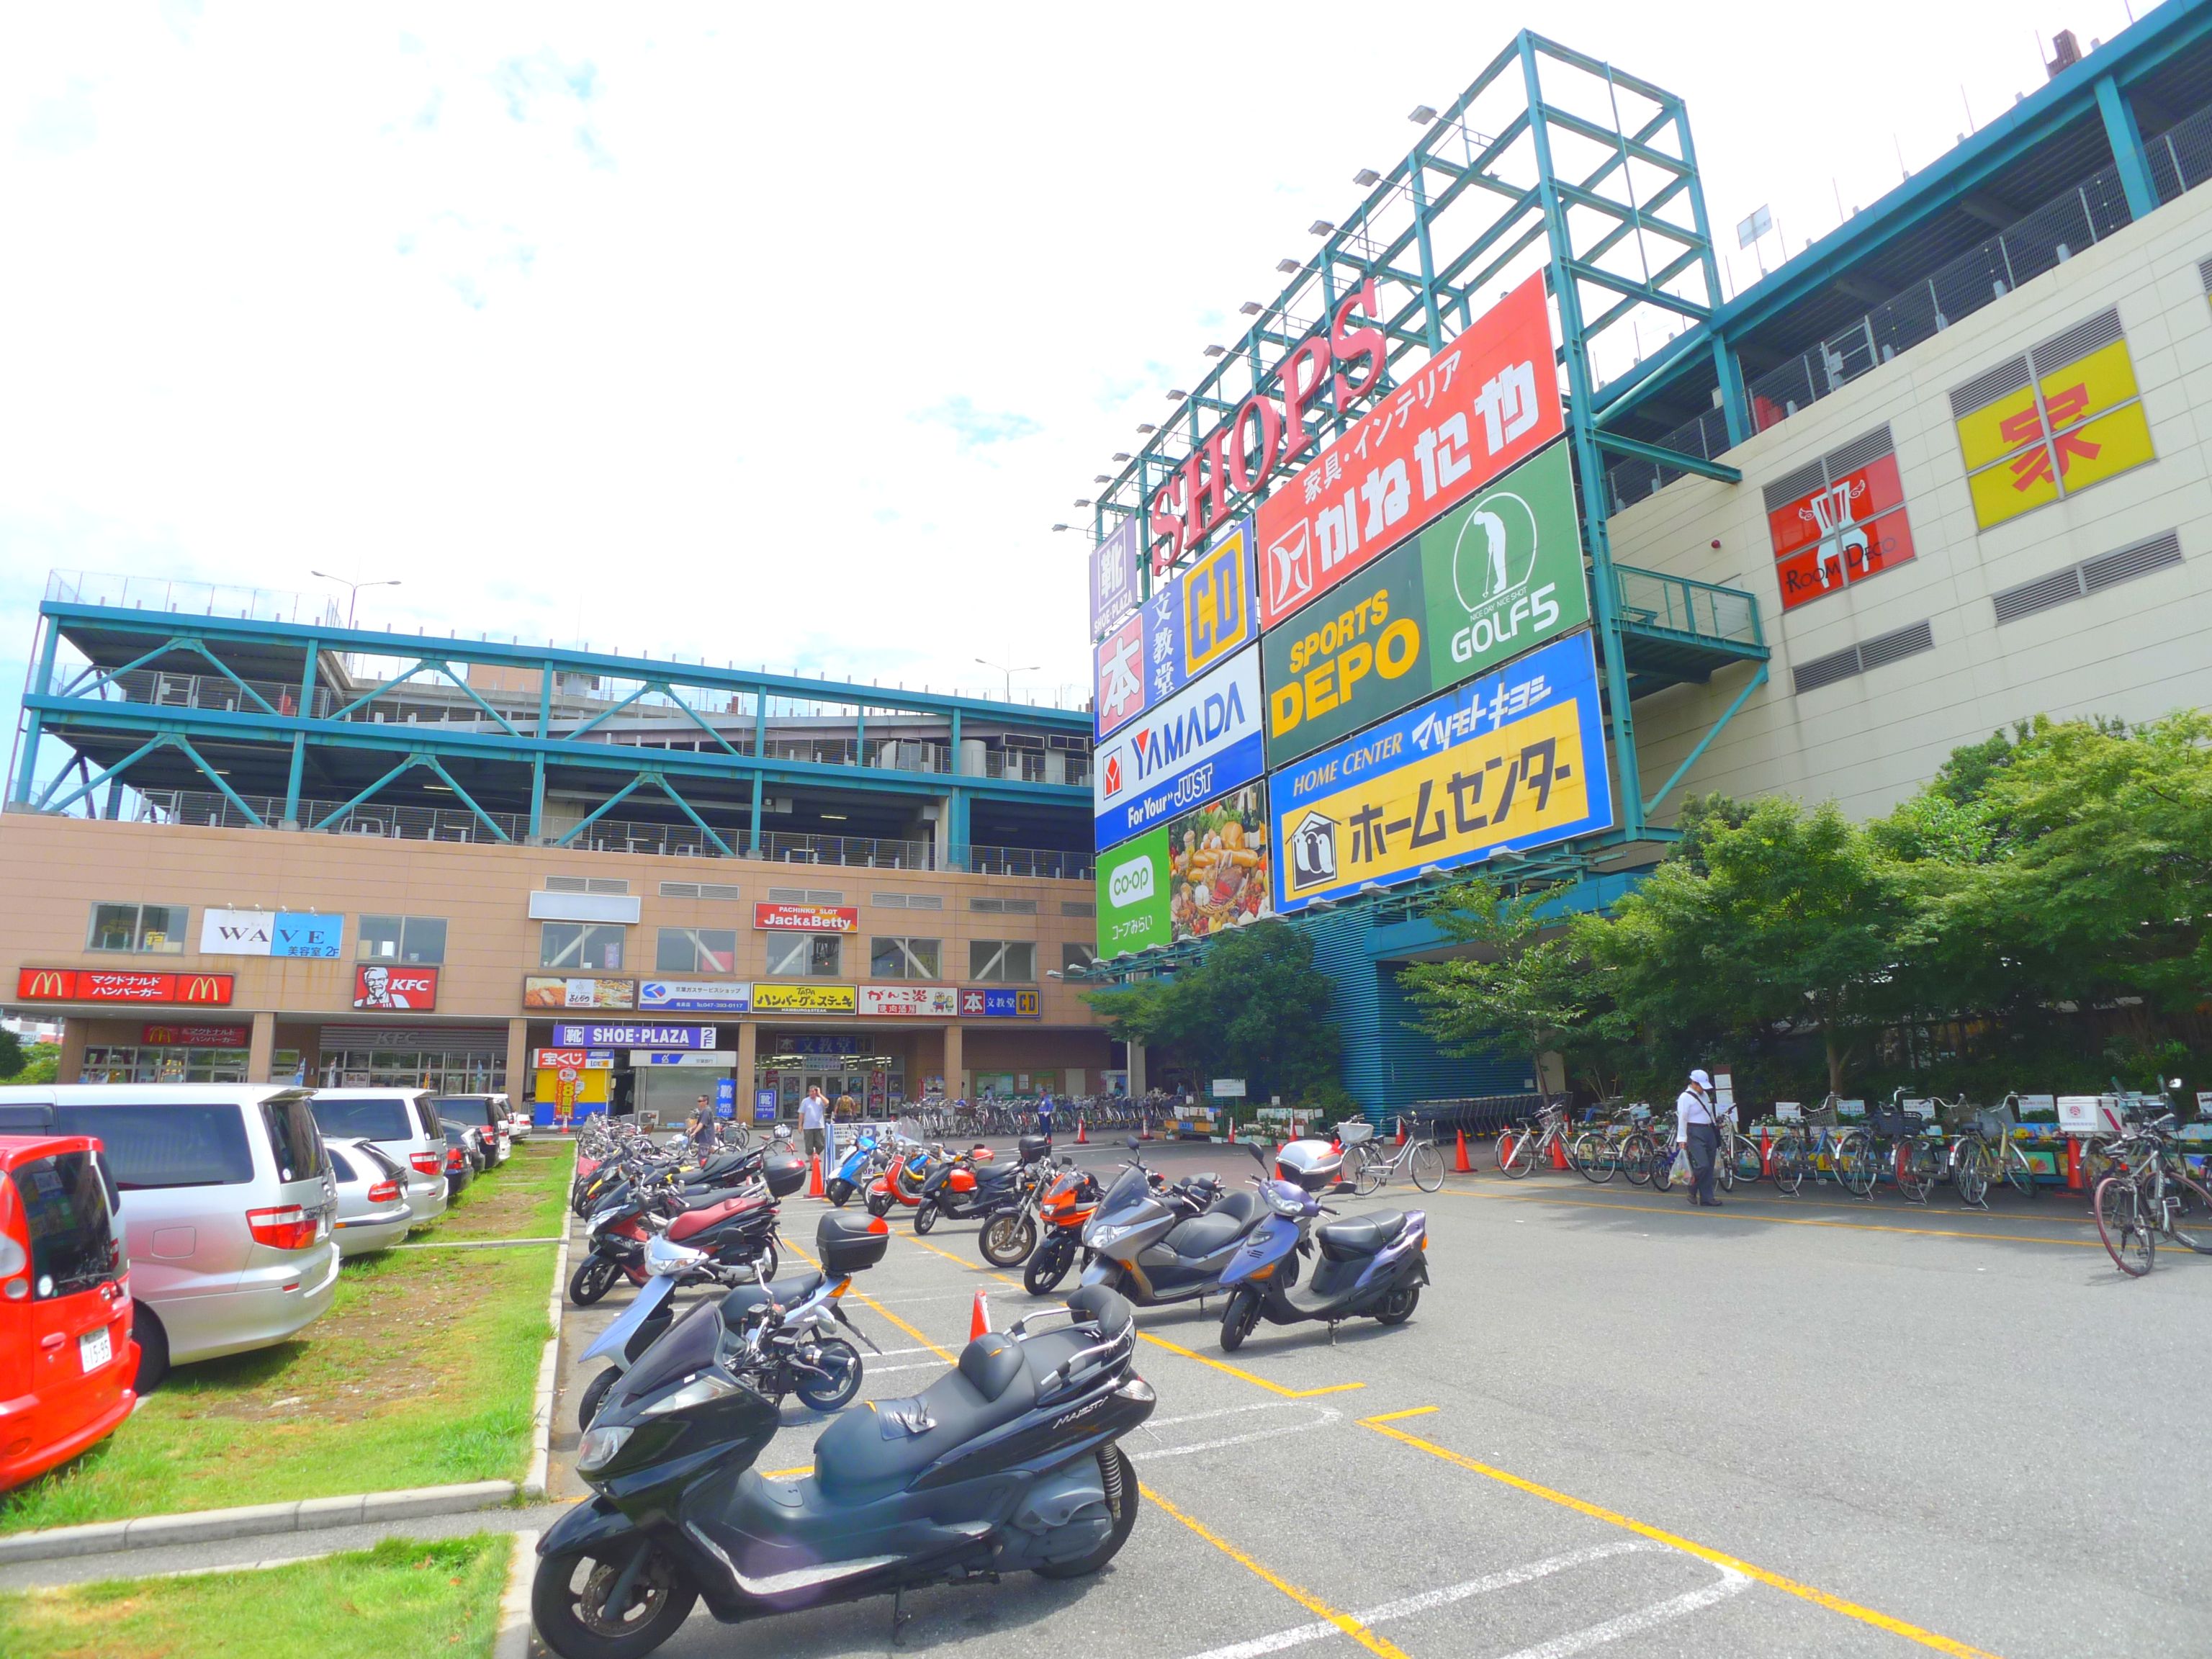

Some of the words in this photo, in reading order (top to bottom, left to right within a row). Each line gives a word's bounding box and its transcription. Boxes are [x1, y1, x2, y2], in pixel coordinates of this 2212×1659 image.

[1154, 278, 1386, 576] SHOPS
[1303, 349, 1461, 504] 家具・インテリア
[2000, 382, 2103, 493] 家
[1315, 360, 1539, 572] かねたや
[1101, 541, 1123, 598] 靴
[1190, 549, 1238, 660] CD
[1290, 588, 1388, 674] SPORTS
[1451, 582, 1560, 663] GOLF5
[1470, 610, 1484, 622] NICE
[1483, 604, 1496, 617] DAY
[1496, 595, 1511, 608] NICE
[1511, 586, 1527, 601] SHOT
[1102, 637, 1140, 717] 本
[1152, 592, 1174, 702] 文教堂
[1270, 617, 1420, 739] DEPO
[1130, 682, 1245, 781] YAMADA
[1411, 675, 1552, 751] マツモトキヨシ
[1293, 760, 1338, 797] HOME
[1343, 732, 1403, 775] CENTER
[1128, 806, 1143, 829] For
[1174, 763, 1213, 808] JUST
[1349, 737, 1572, 864] ホームセンター
[218, 927, 324, 944] WAVE
[288, 946, 321, 956] 美容室
[325, 946, 339, 957] 2F
[764, 914, 851, 930] Jack&Betty
[1111, 914, 1152, 941] コープみらい
[91, 975, 161, 986] マクドナルド
[92, 987, 163, 997] ハンバーガー
[390, 979, 431, 992] KFC
[867, 989, 927, 1002] がんこ炎
[964, 993, 982, 1012] 本
[986, 997, 1015, 1007] 文教堂
[1019, 994, 1035, 1011] CD
[374, 1032, 419, 1044] KFC
[542, 1052, 582, 1065] 宝くじ
[566, 1028, 582, 1043] 靴
[703, 1029, 714, 1047] 2F
[863, 1128, 873, 1137] P
